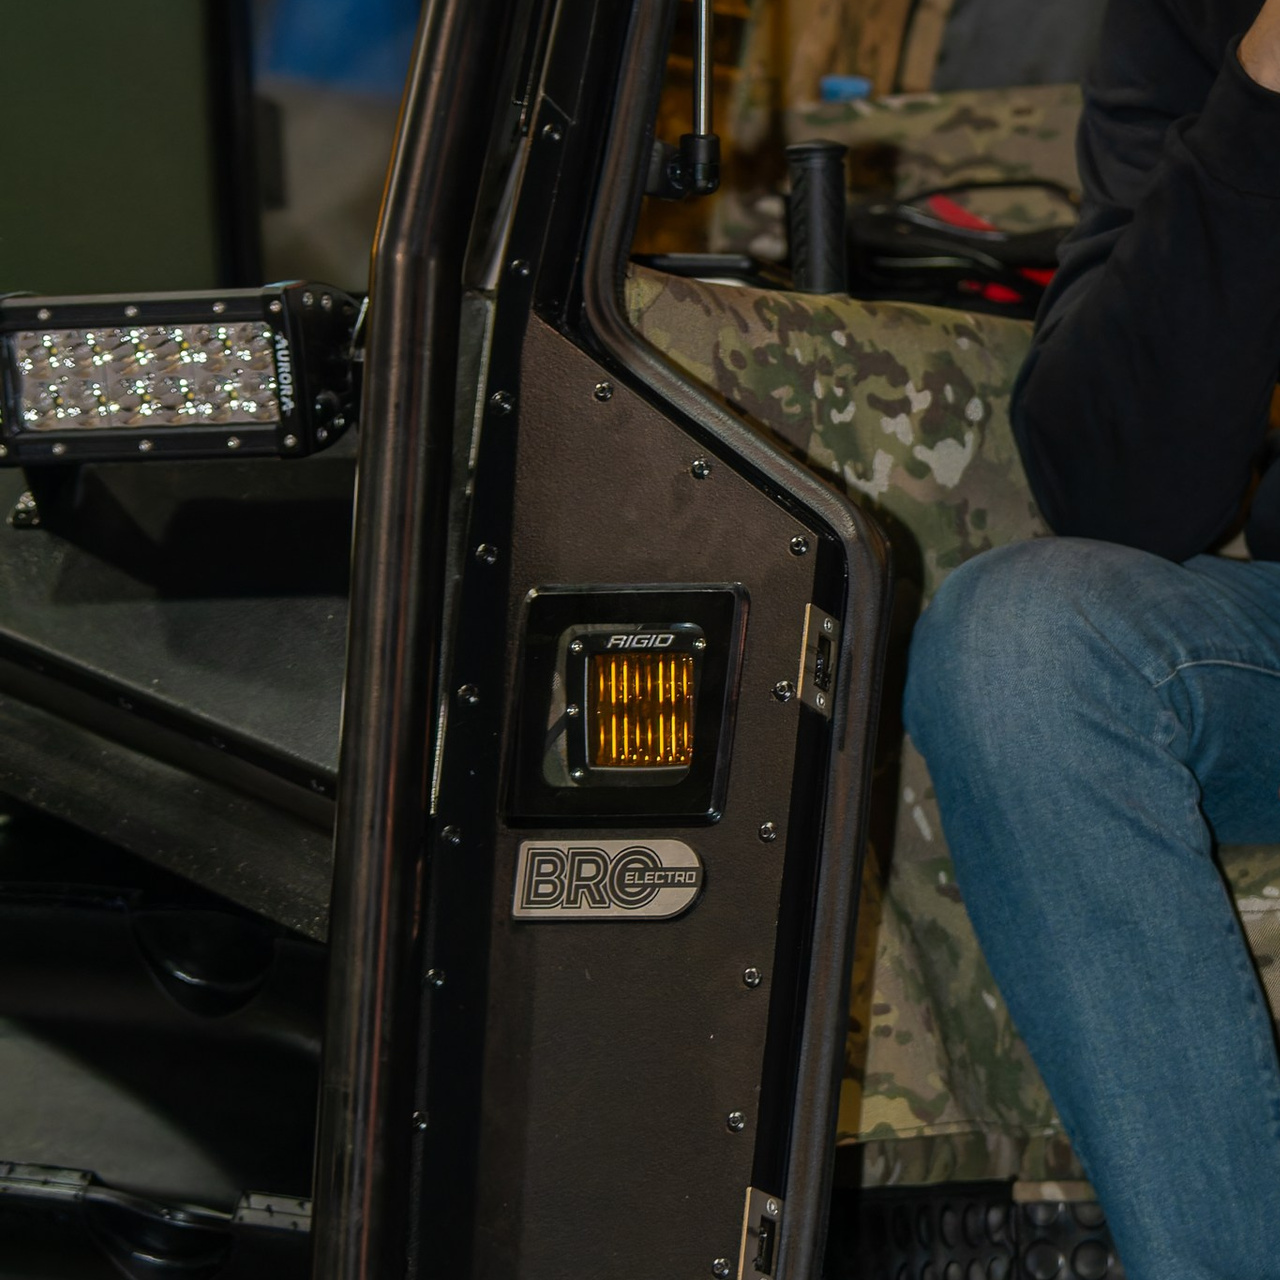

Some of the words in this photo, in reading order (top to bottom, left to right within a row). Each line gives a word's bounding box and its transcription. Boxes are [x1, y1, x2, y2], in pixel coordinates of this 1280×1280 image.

[274, 331, 296, 417] AURORA
[605, 633, 676, 649] RIGID
[623, 870, 697, 885] ELECTRO
